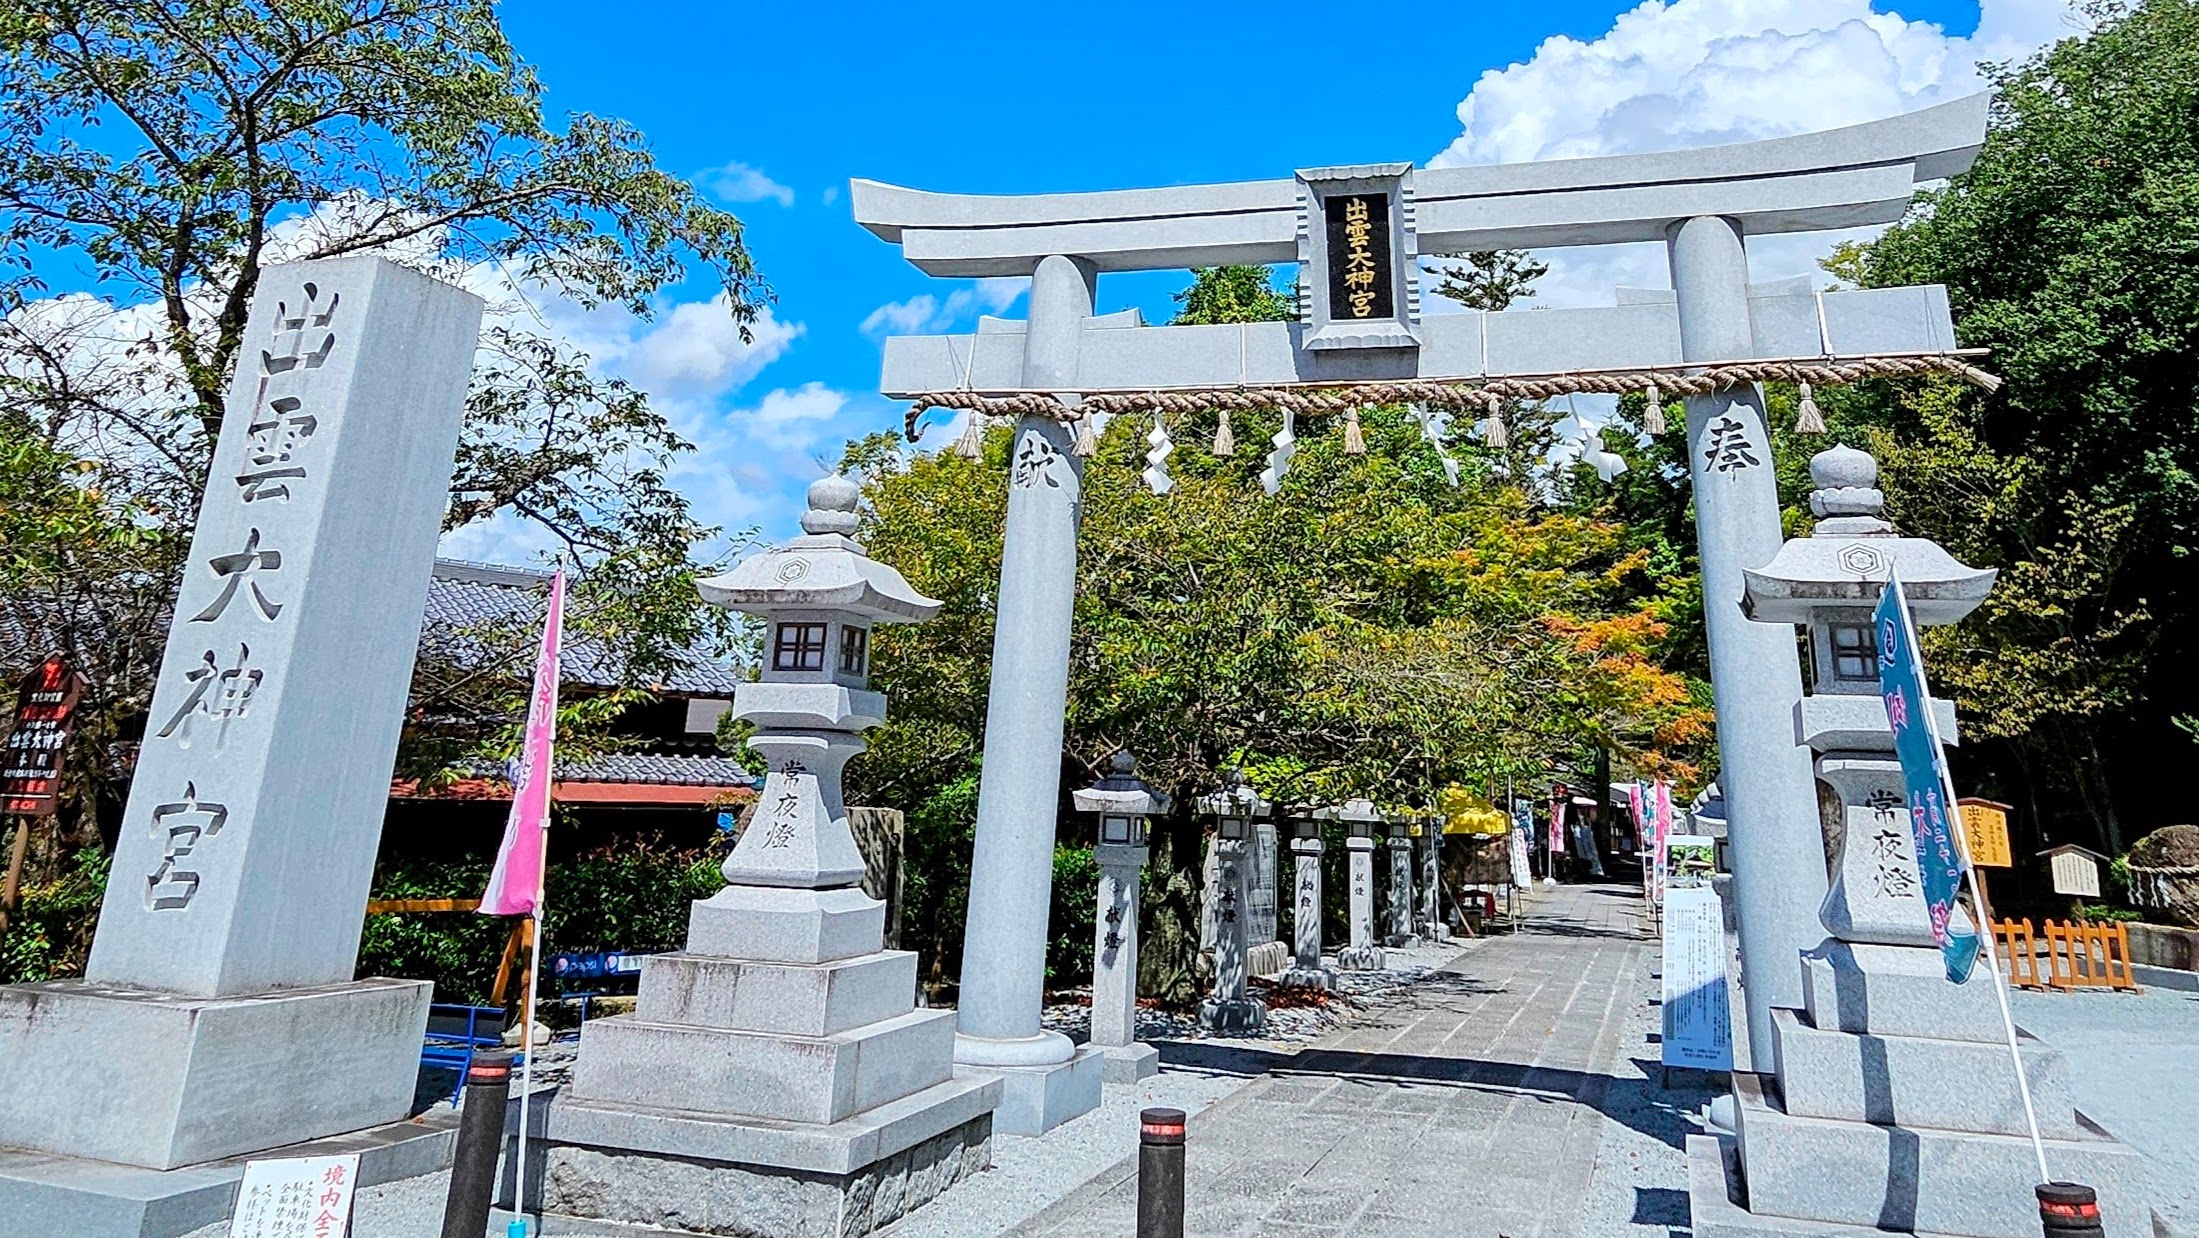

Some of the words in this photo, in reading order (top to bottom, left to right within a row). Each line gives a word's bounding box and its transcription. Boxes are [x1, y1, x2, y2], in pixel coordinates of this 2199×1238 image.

[1343, 198, 1375, 317] 出雲大神宮
[1704, 417, 1761, 483] 奉
[144, 281, 340, 912] 出雲大神宮
[761, 759, 806, 849] 常夜燈
[1865, 788, 1917, 899] 常夜燈
[312, 1164, 347, 1238] 境内全
